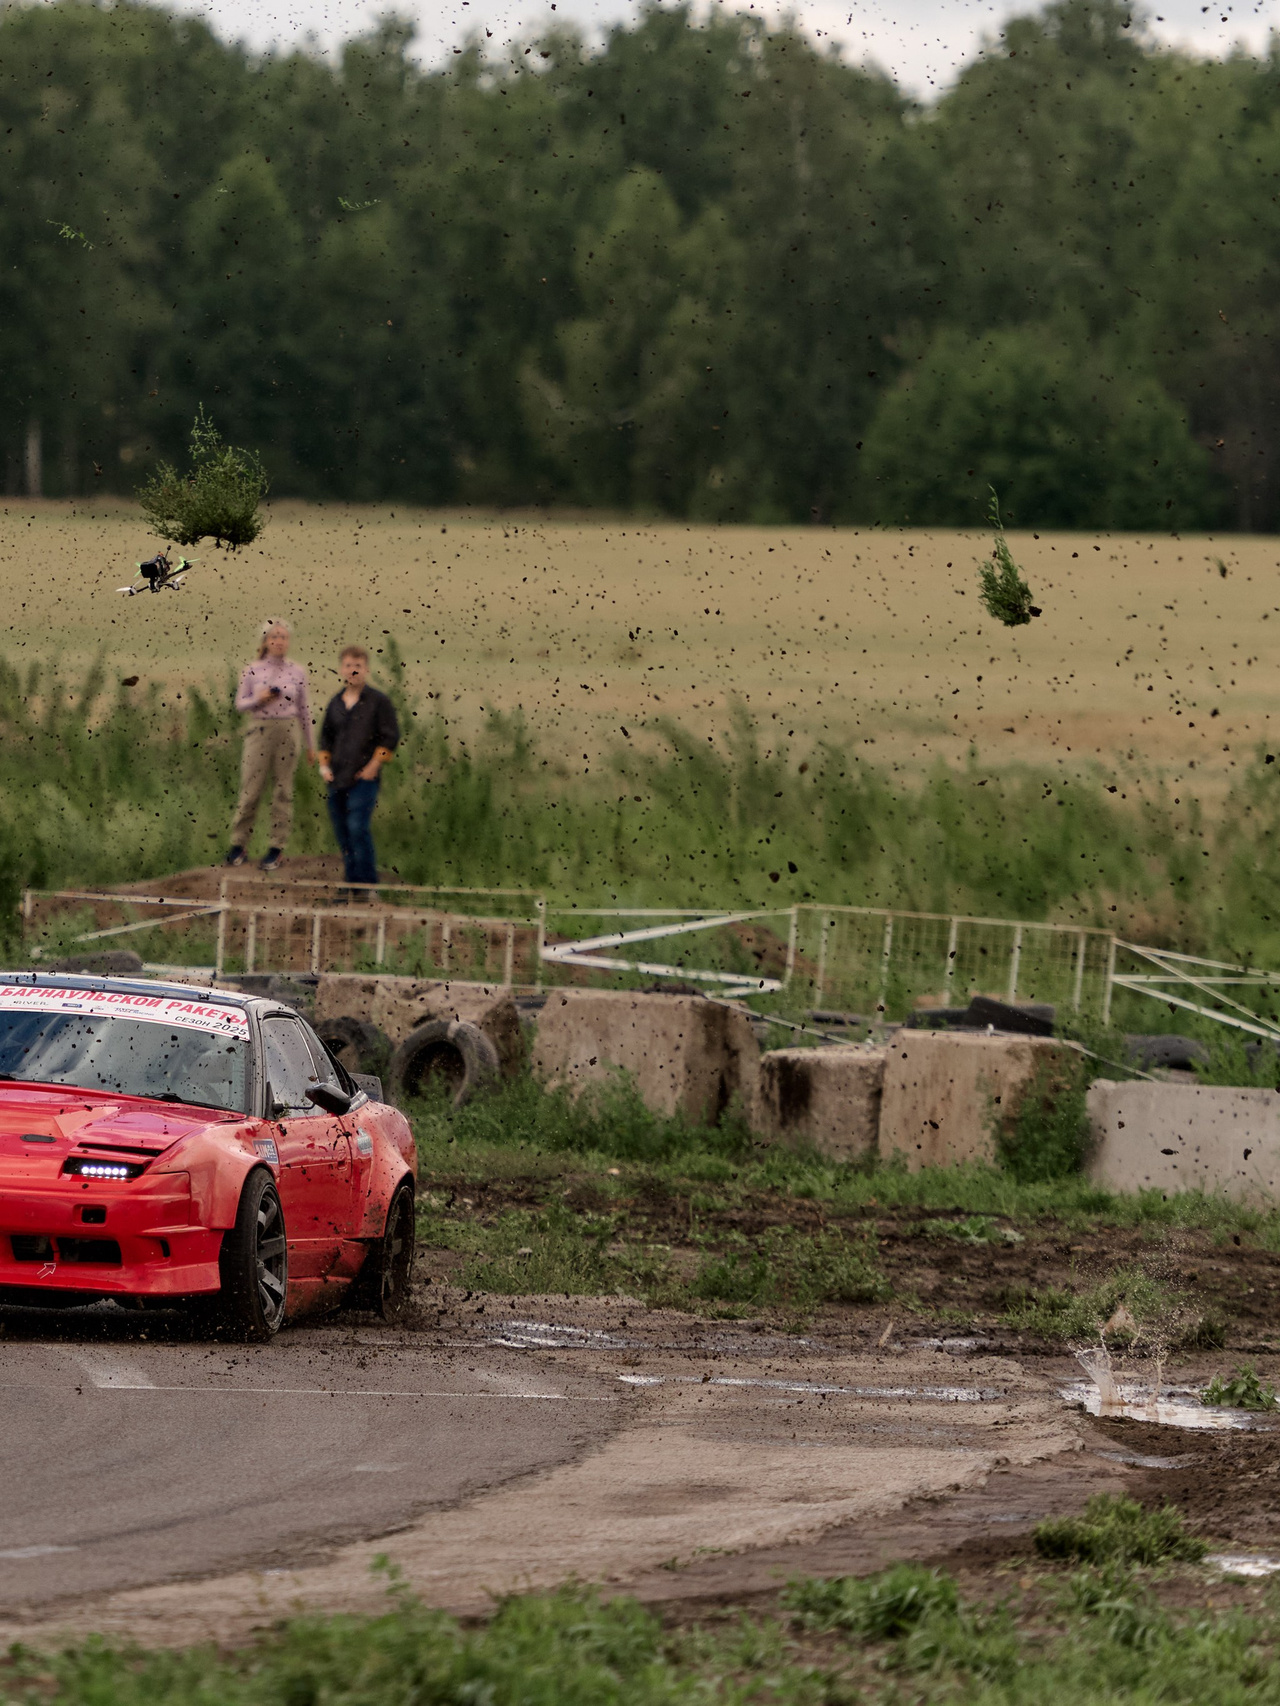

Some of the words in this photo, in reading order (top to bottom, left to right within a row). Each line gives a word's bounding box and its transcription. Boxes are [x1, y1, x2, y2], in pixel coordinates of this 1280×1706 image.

[0, 987, 163, 1008] БАРНАУЛЬСКОЙ
[166, 1001, 248, 1026] РАКЕТЫ
[174, 1016, 210, 1027] СЕЗОН
[213, 1022, 248, 1036] 2025
